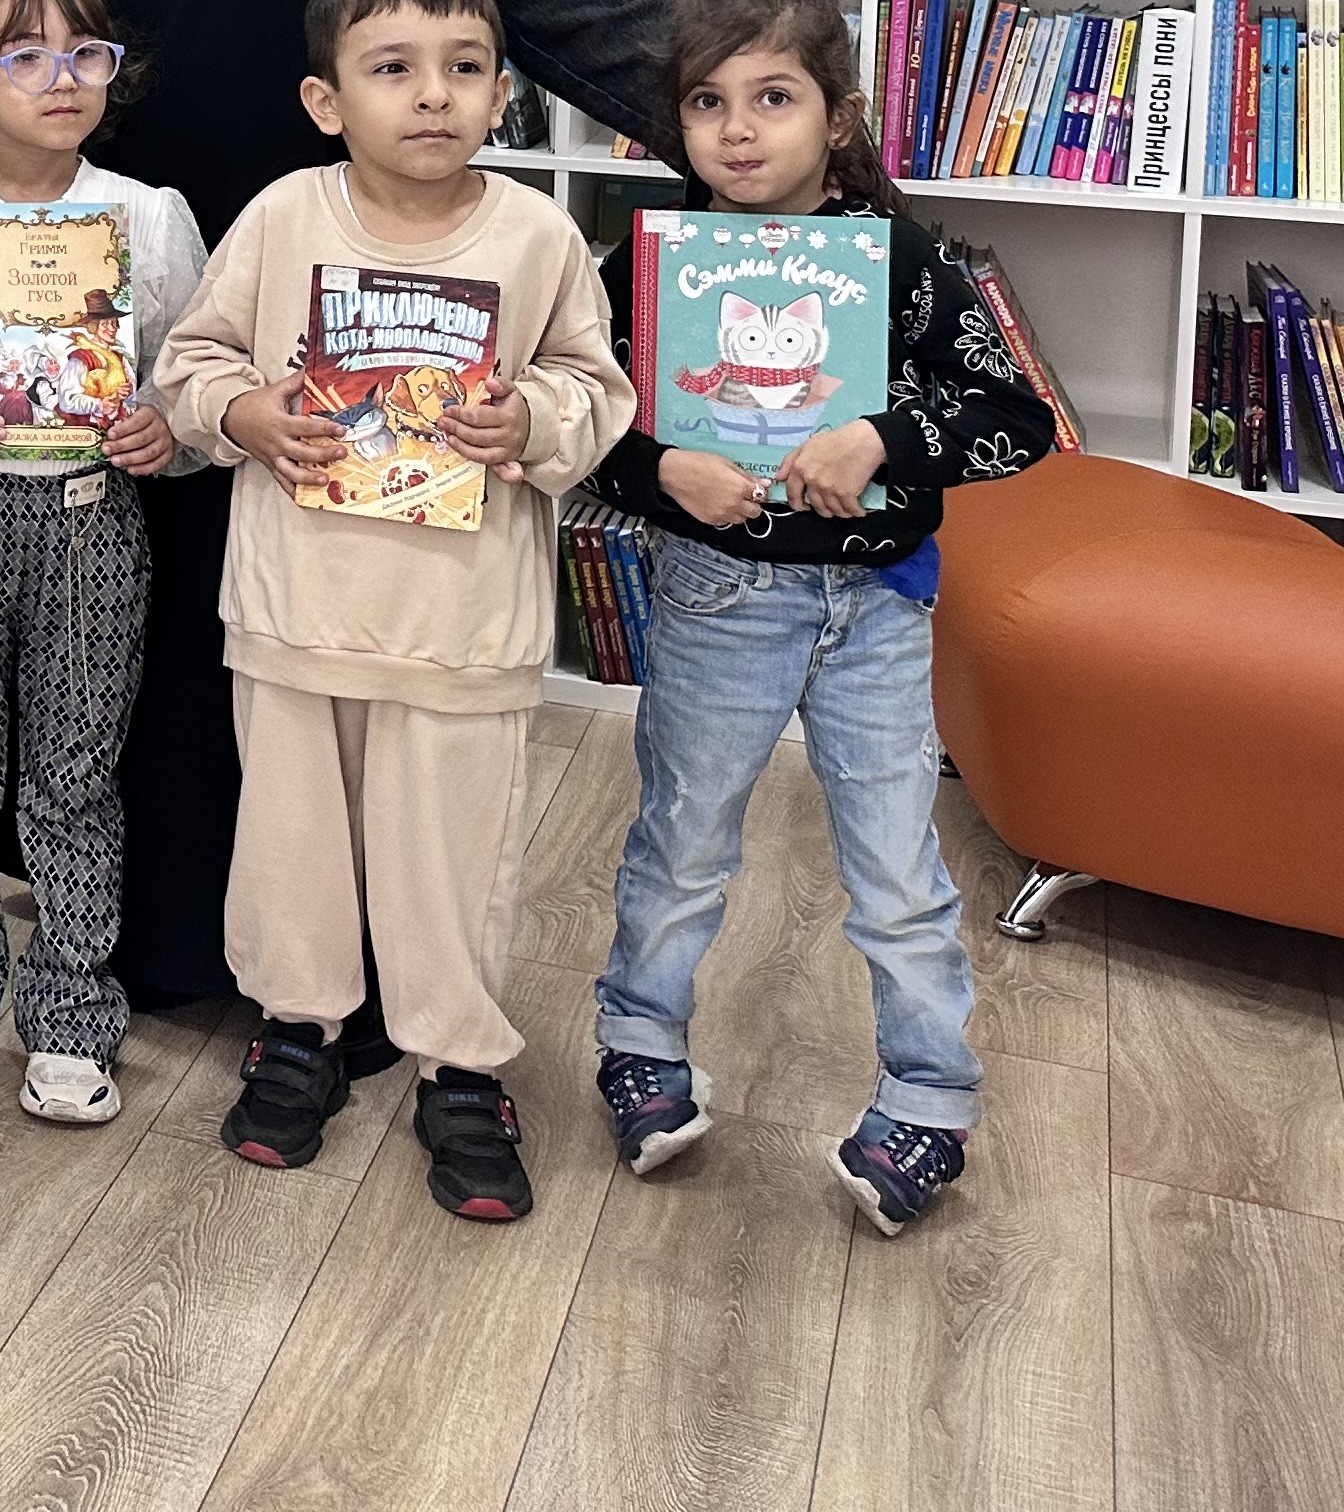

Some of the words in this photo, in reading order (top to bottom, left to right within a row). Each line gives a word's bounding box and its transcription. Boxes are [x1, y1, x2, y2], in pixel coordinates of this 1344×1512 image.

[1150, 15, 1179, 67] пони
[1133, 71, 1181, 190] Принцессы
[18, 240, 69, 257] ГРИММ
[7, 268, 79, 287] ЗОЛОТОЙ
[27, 288, 64, 304] ГУСЬ
[677, 255, 778, 299] Сэмми
[779, 252, 869, 307] Клаус
[321, 288, 492, 340] ПРИКЛЮЧЕНИЯ
[983, 278, 1016, 330] СКАЗКИ
[324, 328, 484, 364] КОТА-ИНОПЛАНЕТЯНИНА
[1006, 325, 1048, 396] НАРОДНЫЕ
[41, 432, 54, 442] ЗА
[55, 431, 93, 443] СКАЗКОЙ
